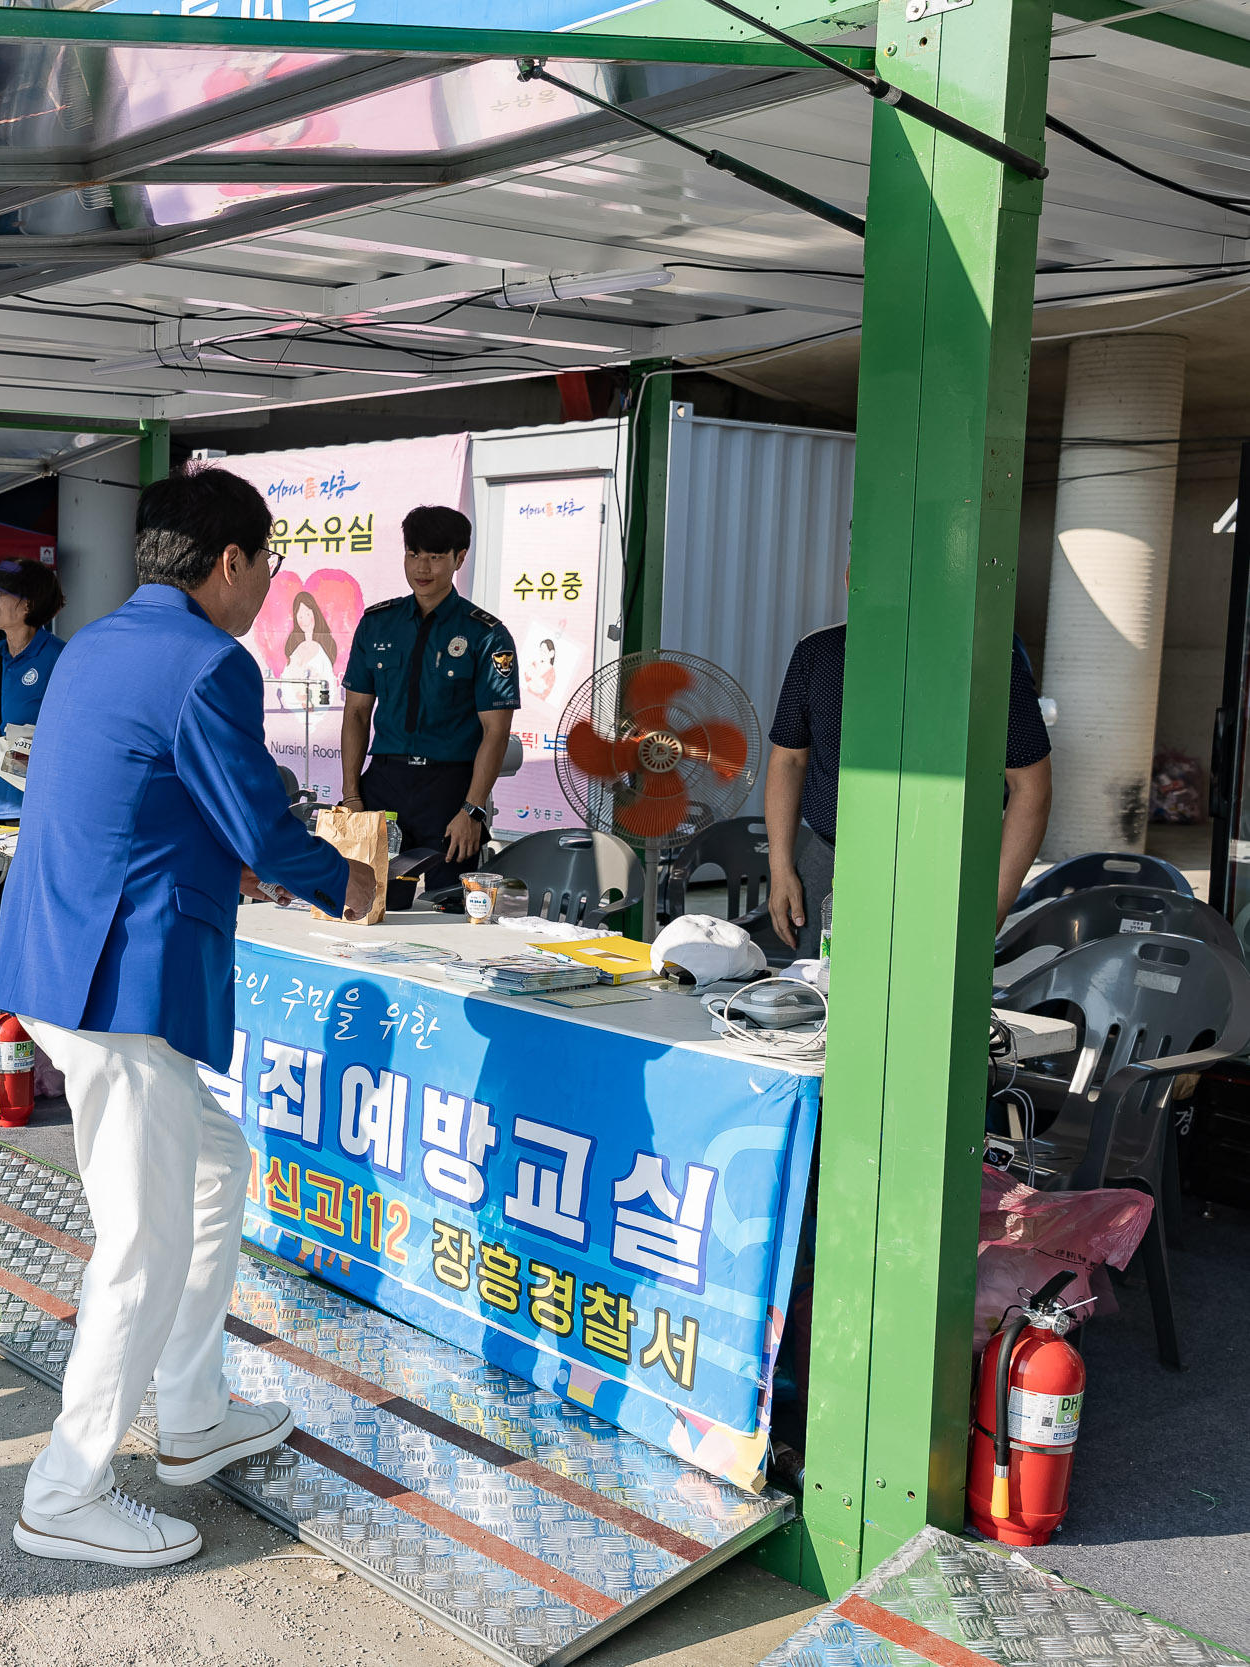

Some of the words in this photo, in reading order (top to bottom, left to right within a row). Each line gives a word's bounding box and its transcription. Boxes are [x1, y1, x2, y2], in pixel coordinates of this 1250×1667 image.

[320, 470, 360, 500] 장흥
[556, 498, 585, 517] 장흥
[268, 512, 373, 556] 유수유실
[513, 571, 583, 601] 수유중
[270, 741, 307, 759] Nursing
[533, 808, 563, 821] 장흥군
[281, 977, 362, 1041] 주민을
[379, 1002, 442, 1050] 위한
[16, 1043, 28, 1051] DH
[432, 1219, 699, 1391] 장흥경찰서
[1061, 1398, 1079, 1411] DH
